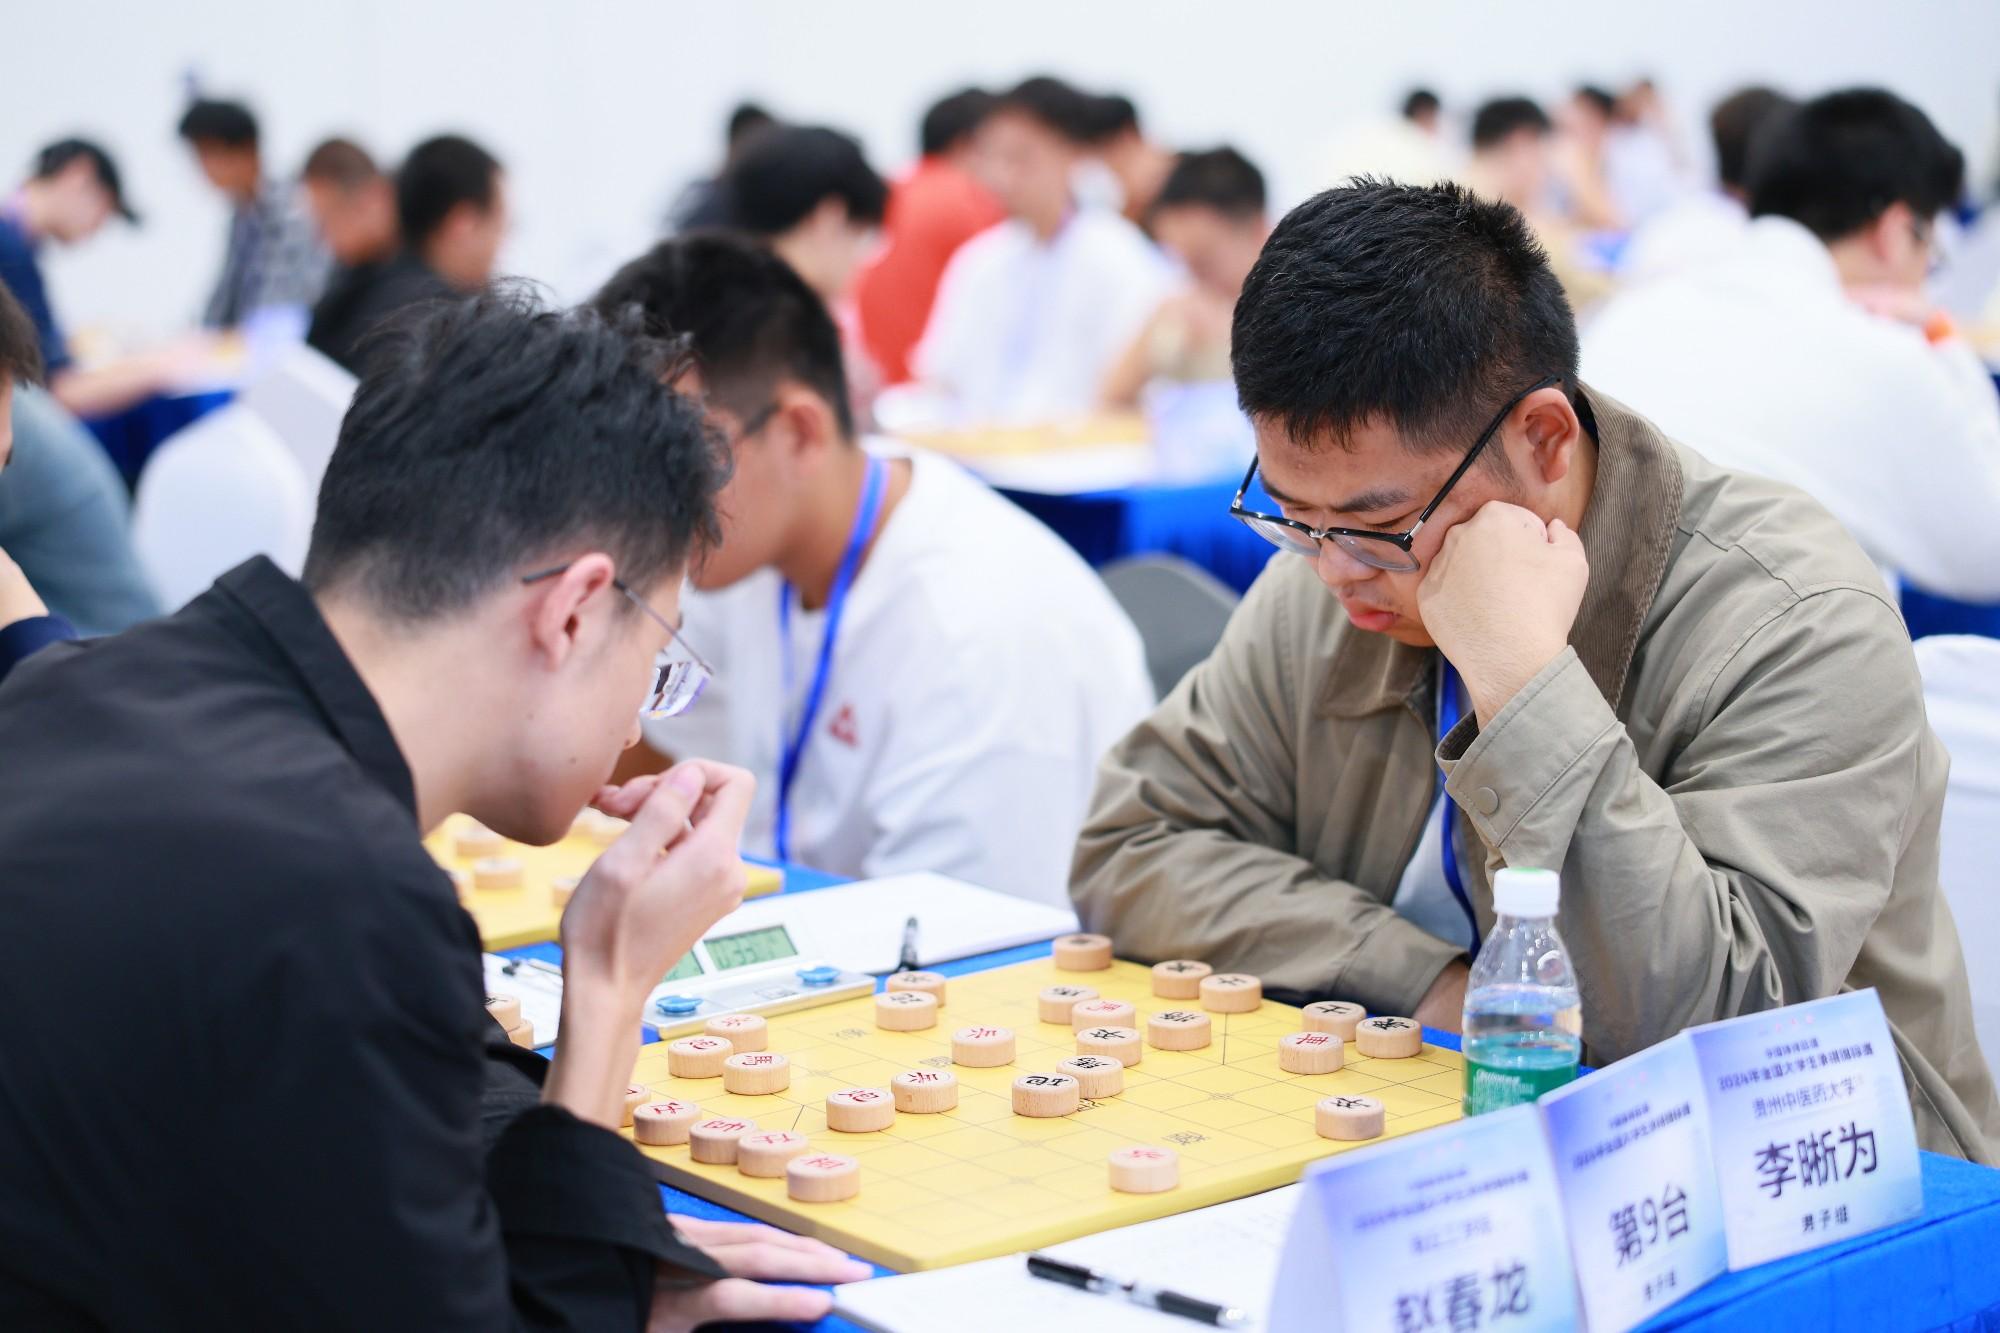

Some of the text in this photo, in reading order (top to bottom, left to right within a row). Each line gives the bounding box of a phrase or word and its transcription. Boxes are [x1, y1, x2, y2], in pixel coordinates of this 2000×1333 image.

[1314, 1004, 1352, 1015] 士
[1296, 1032, 1330, 1046] 車
[1752, 1077, 1858, 1119] 贵州中医药大学
[1754, 1120, 1879, 1200] 李晰为
[1609, 1183, 1691, 1270] 第9台
